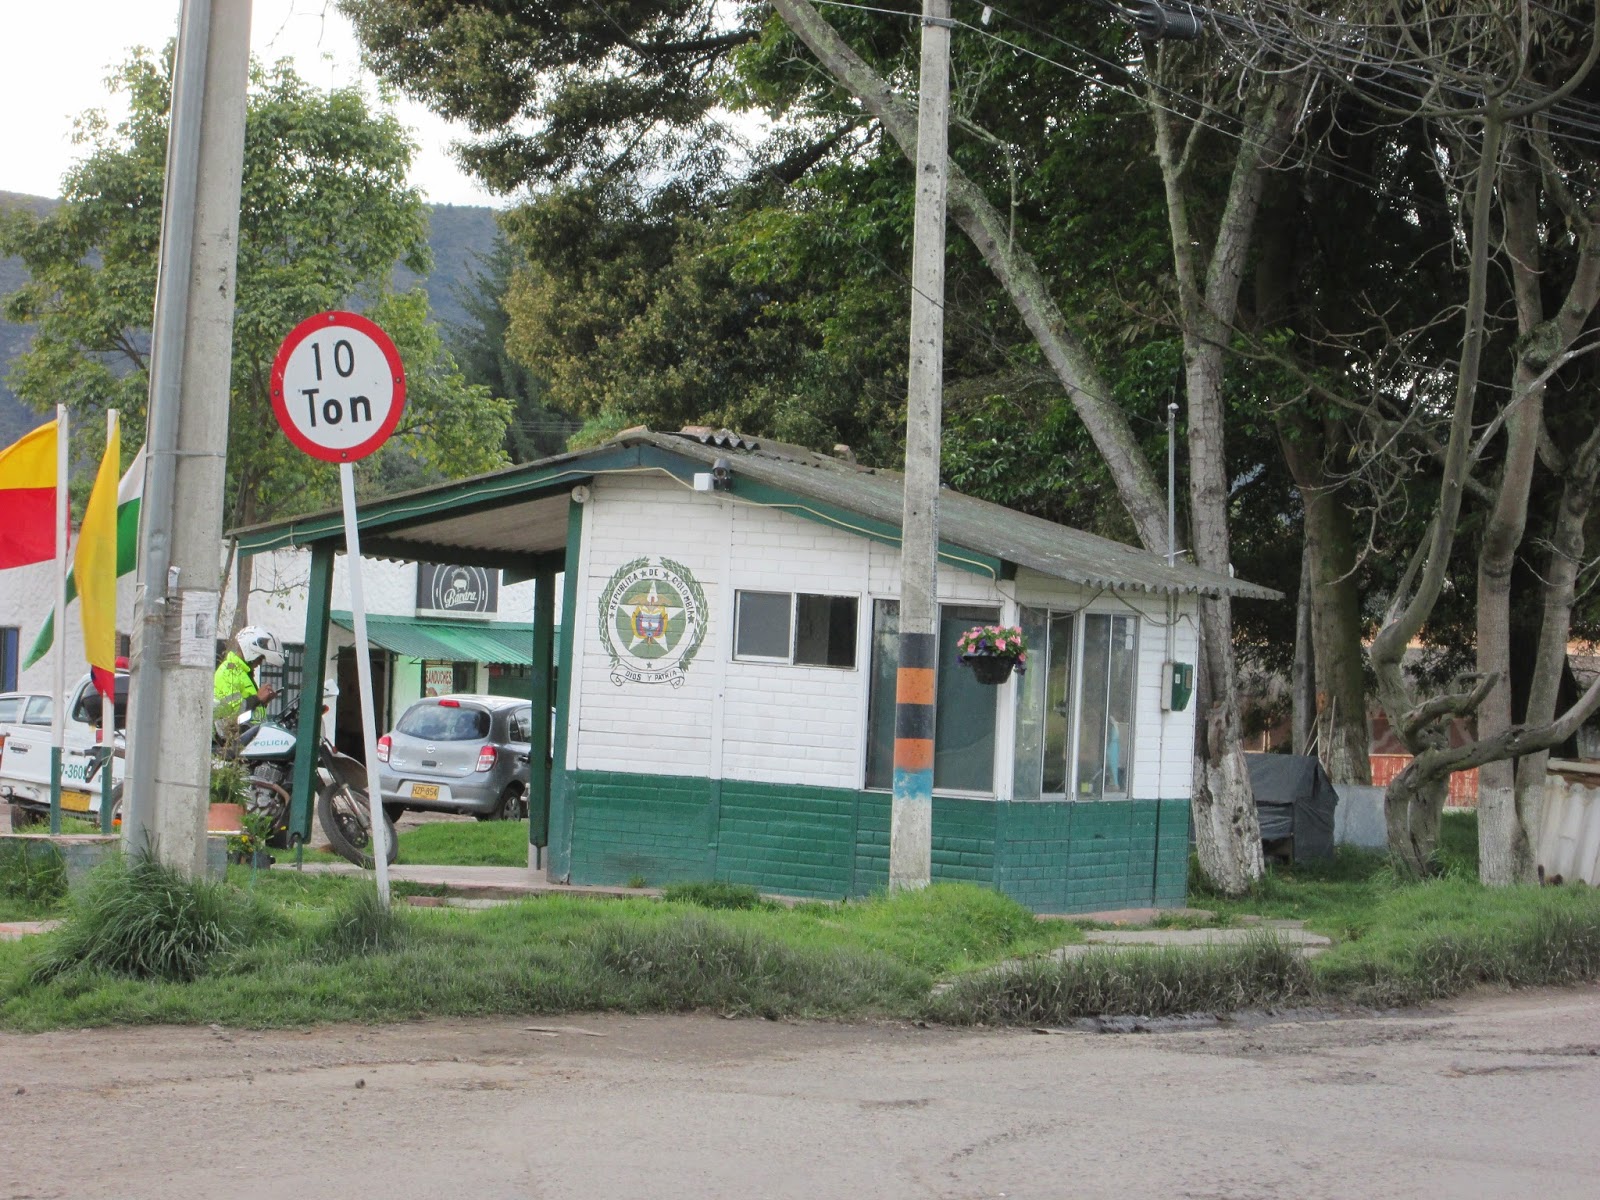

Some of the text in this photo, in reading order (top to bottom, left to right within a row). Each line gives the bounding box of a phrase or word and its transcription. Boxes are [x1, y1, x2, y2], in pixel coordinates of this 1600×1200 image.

[311, 339, 355, 381] 10
[301, 388, 372, 428] Ton
[609, 568, 695, 615] REPUBLICA DE COLOMBIA
[625, 670, 677, 681] DIOS Y PATRIA
[253, 739, 290, 747] POLICIA
